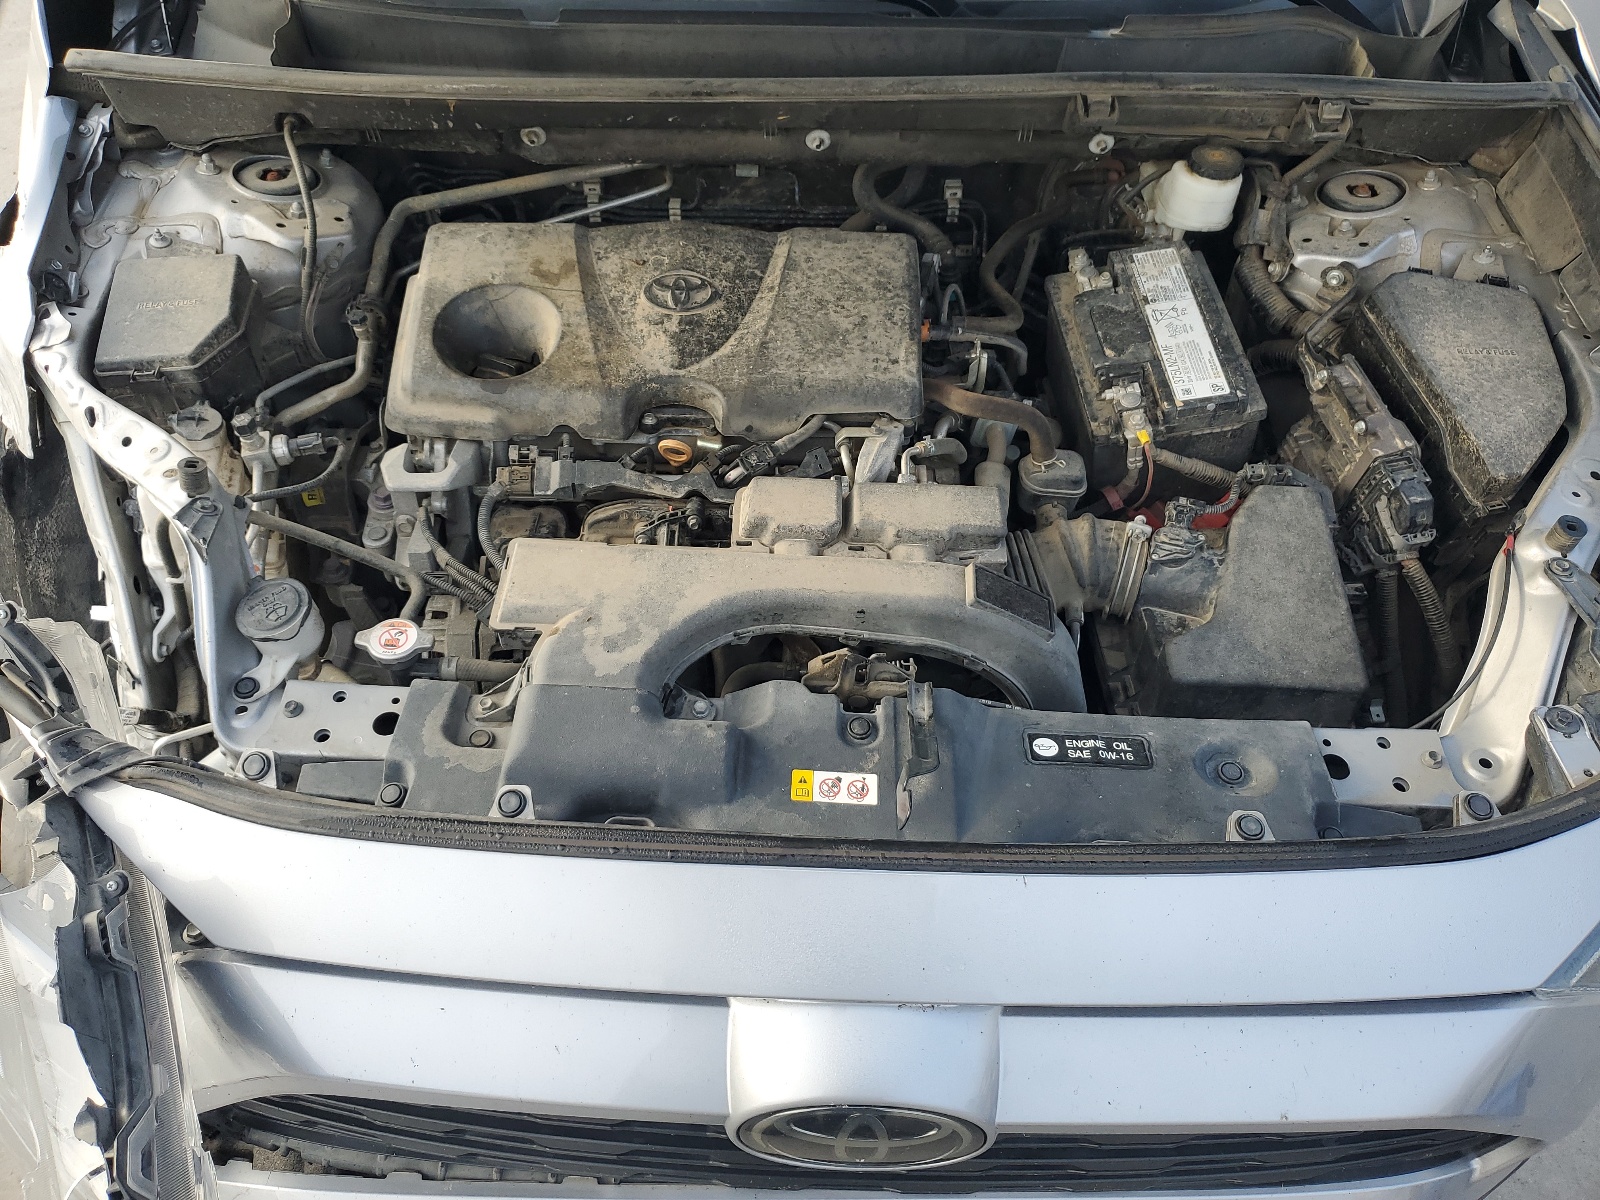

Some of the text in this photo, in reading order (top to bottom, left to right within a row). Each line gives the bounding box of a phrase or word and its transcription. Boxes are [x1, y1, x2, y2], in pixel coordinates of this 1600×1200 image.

[1065, 739, 1133, 751] ENGINE OIL
[1067, 749, 1134, 761] SAE 0W-16
